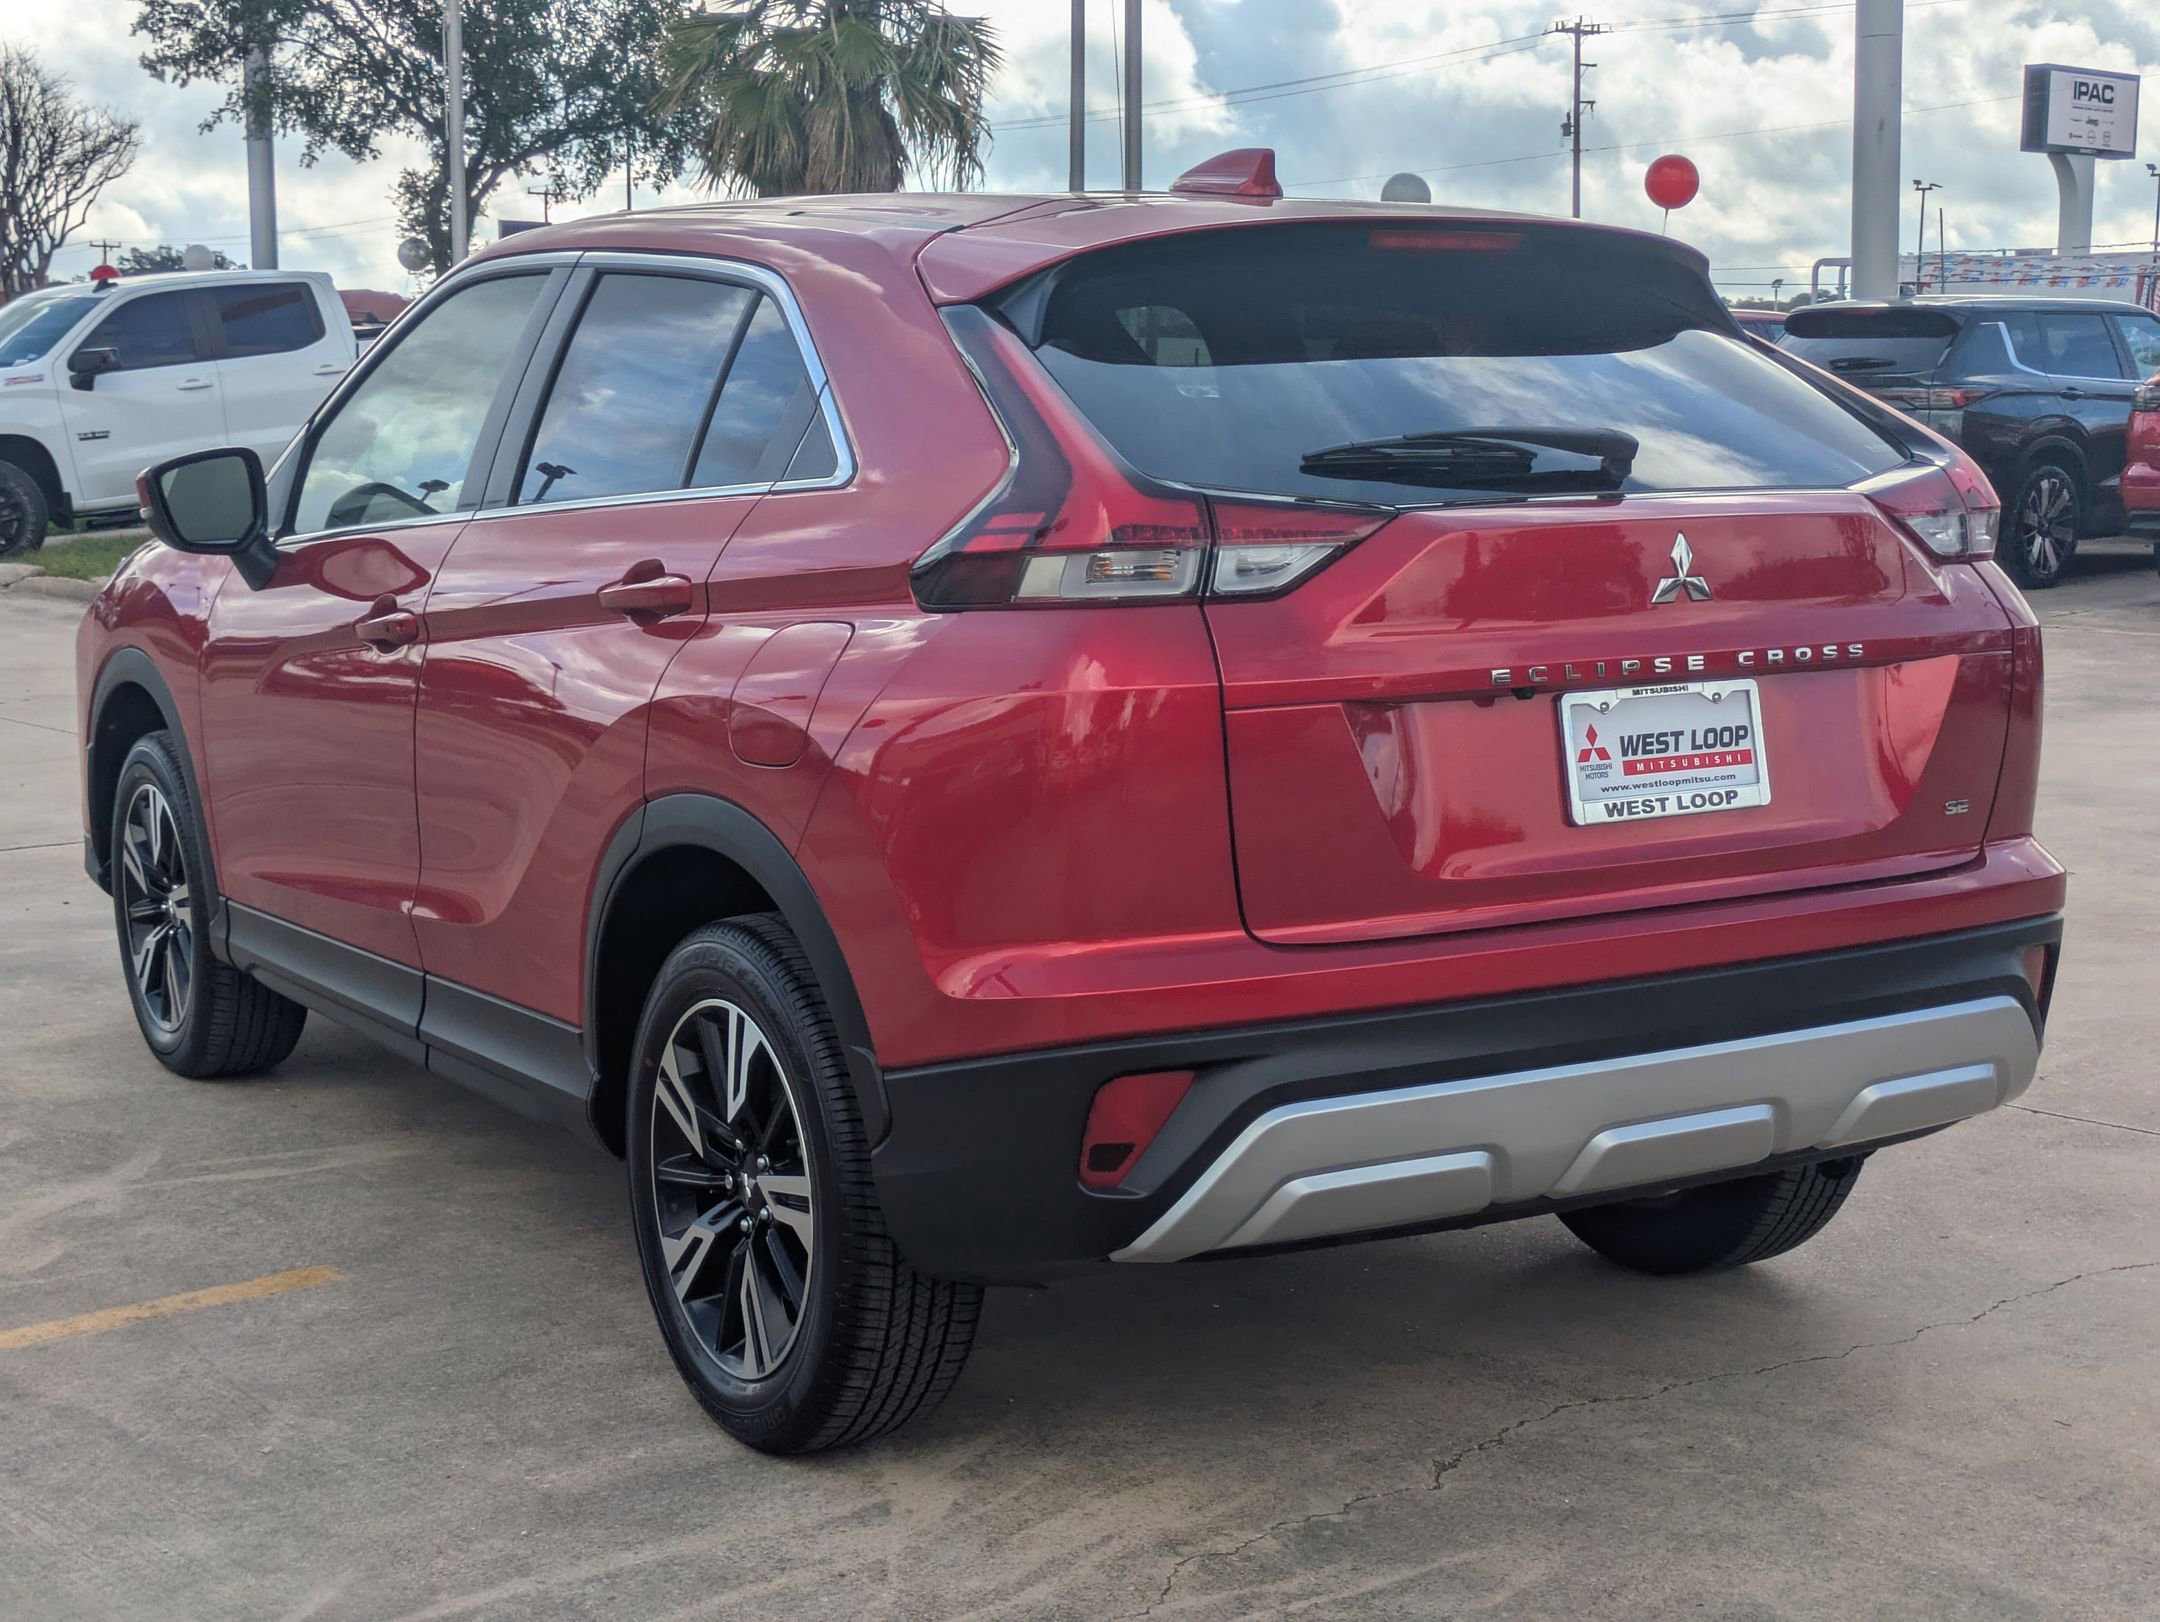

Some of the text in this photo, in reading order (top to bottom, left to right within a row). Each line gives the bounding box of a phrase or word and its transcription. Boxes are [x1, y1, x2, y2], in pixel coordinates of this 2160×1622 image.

[2073, 80, 2114, 104] IPAC
[1491, 643, 1863, 685] ECLIPSE CROSS
[1632, 684, 1689, 696] MITSUBISHI
[1620, 724, 1748, 757] WEST LOOP
[1580, 763, 1612, 772] MITSUBISHI
[1636, 753, 1742, 771] MITSUBISHI
[1585, 771, 1609, 780] MOTORS
[1601, 773, 1736, 793] www.westloopmitsu.com
[1604, 790, 1738, 818] WEST LOOP
[1944, 799, 1969, 815] SE
